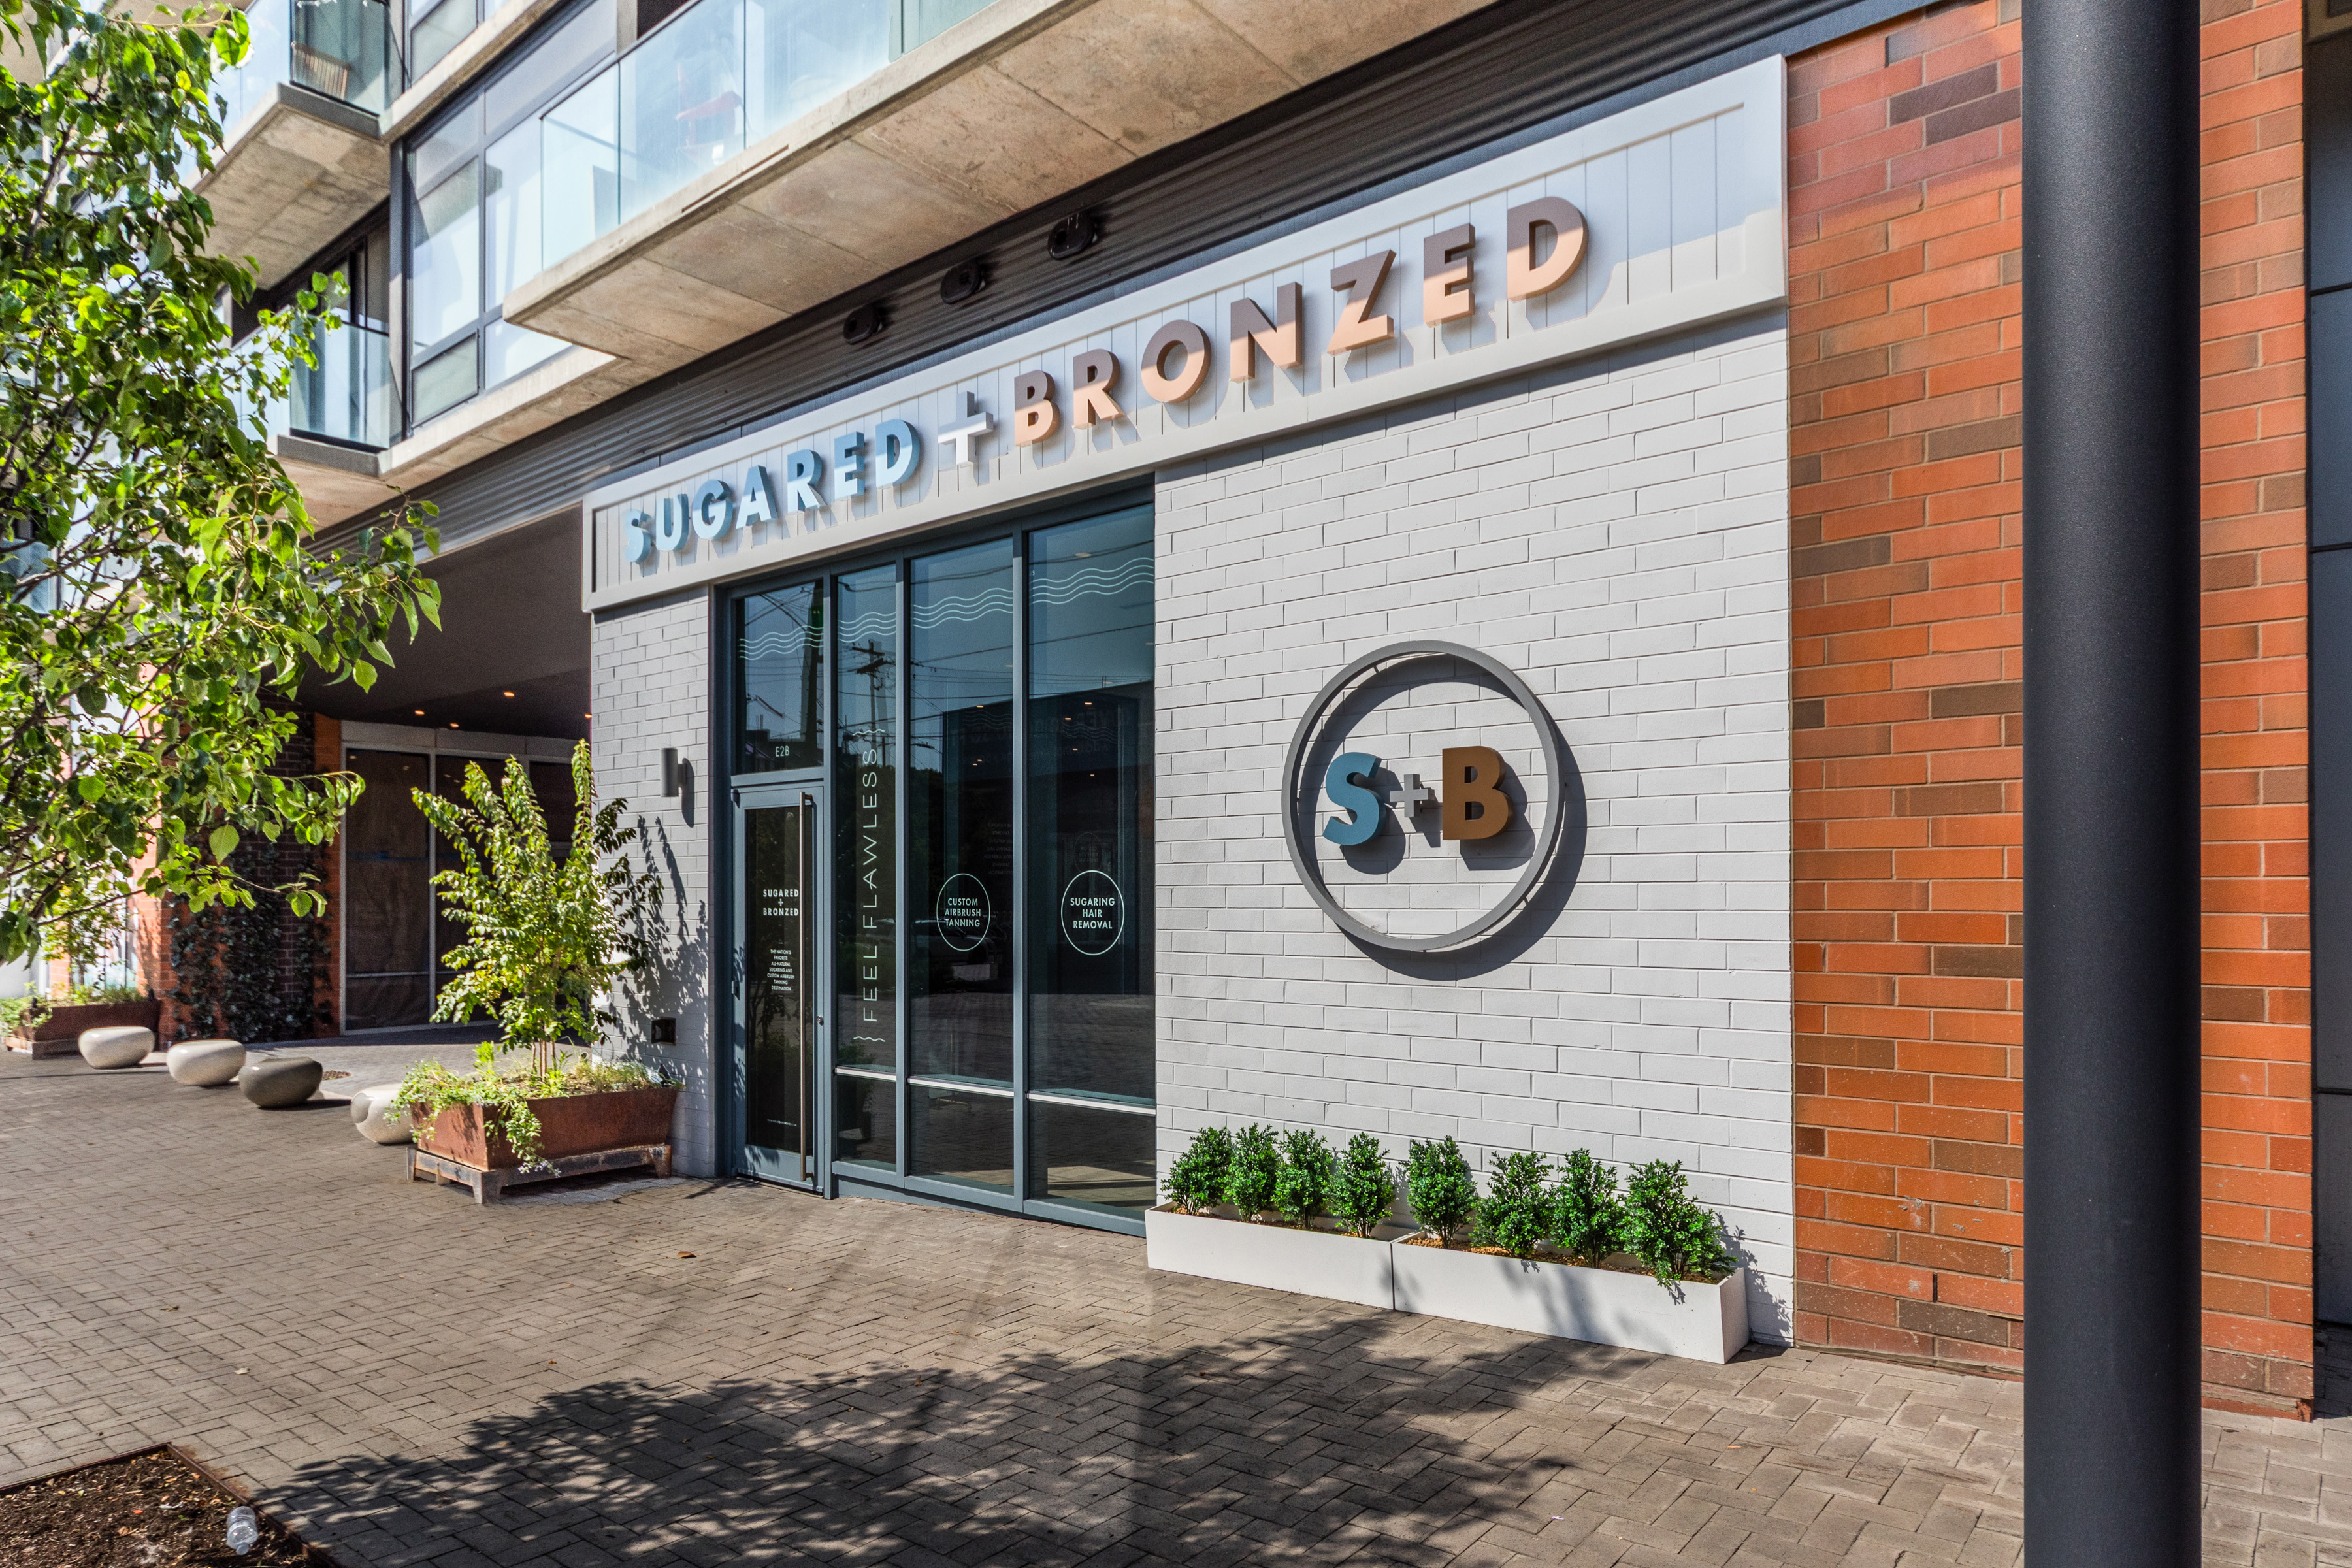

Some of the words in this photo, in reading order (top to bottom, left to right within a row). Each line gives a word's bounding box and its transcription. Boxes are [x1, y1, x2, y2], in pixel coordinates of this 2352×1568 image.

[624, 419, 920, 564] SUGARED
[1014, 196, 1590, 448] BRONZED
[775, 745, 790, 757] E2B
[862, 749, 877, 928] FLAWLESS
[763, 889, 799, 897] SUGARED
[947, 898, 978, 906] CUSTOM
[1070, 897, 1115, 906] SUGARING
[763, 907, 799, 916] BRONZED
[945, 908, 981, 917] AIRBRUSH
[1082, 909, 1103, 918] HAIR
[945, 919, 981, 927] TANNING
[1073, 920, 1113, 929] REMOVAL
[862, 945, 877, 1022] FEEL
